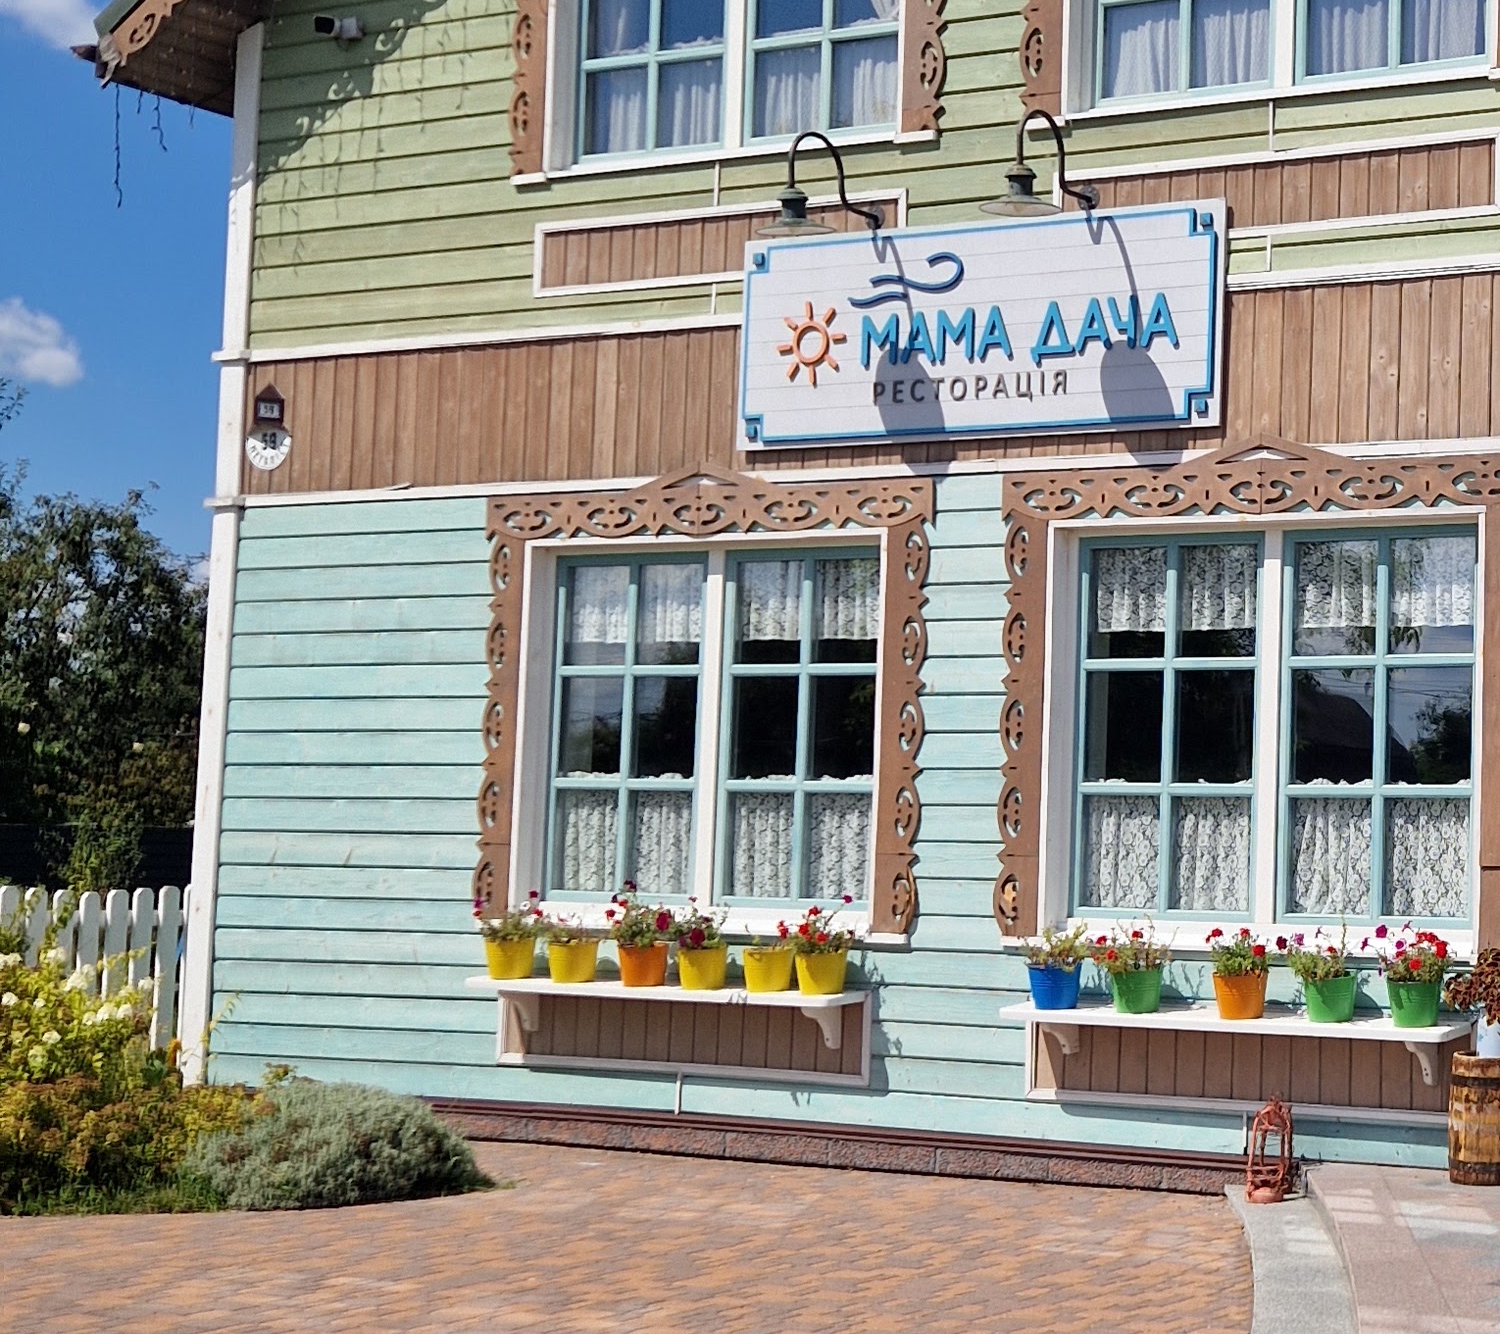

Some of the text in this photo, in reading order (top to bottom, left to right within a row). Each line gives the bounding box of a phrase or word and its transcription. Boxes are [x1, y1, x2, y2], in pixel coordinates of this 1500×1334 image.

[860, 292, 1180, 369] МАМА ДАЧА
[872, 369, 1069, 405] РЕСТОРАЦІЯ
